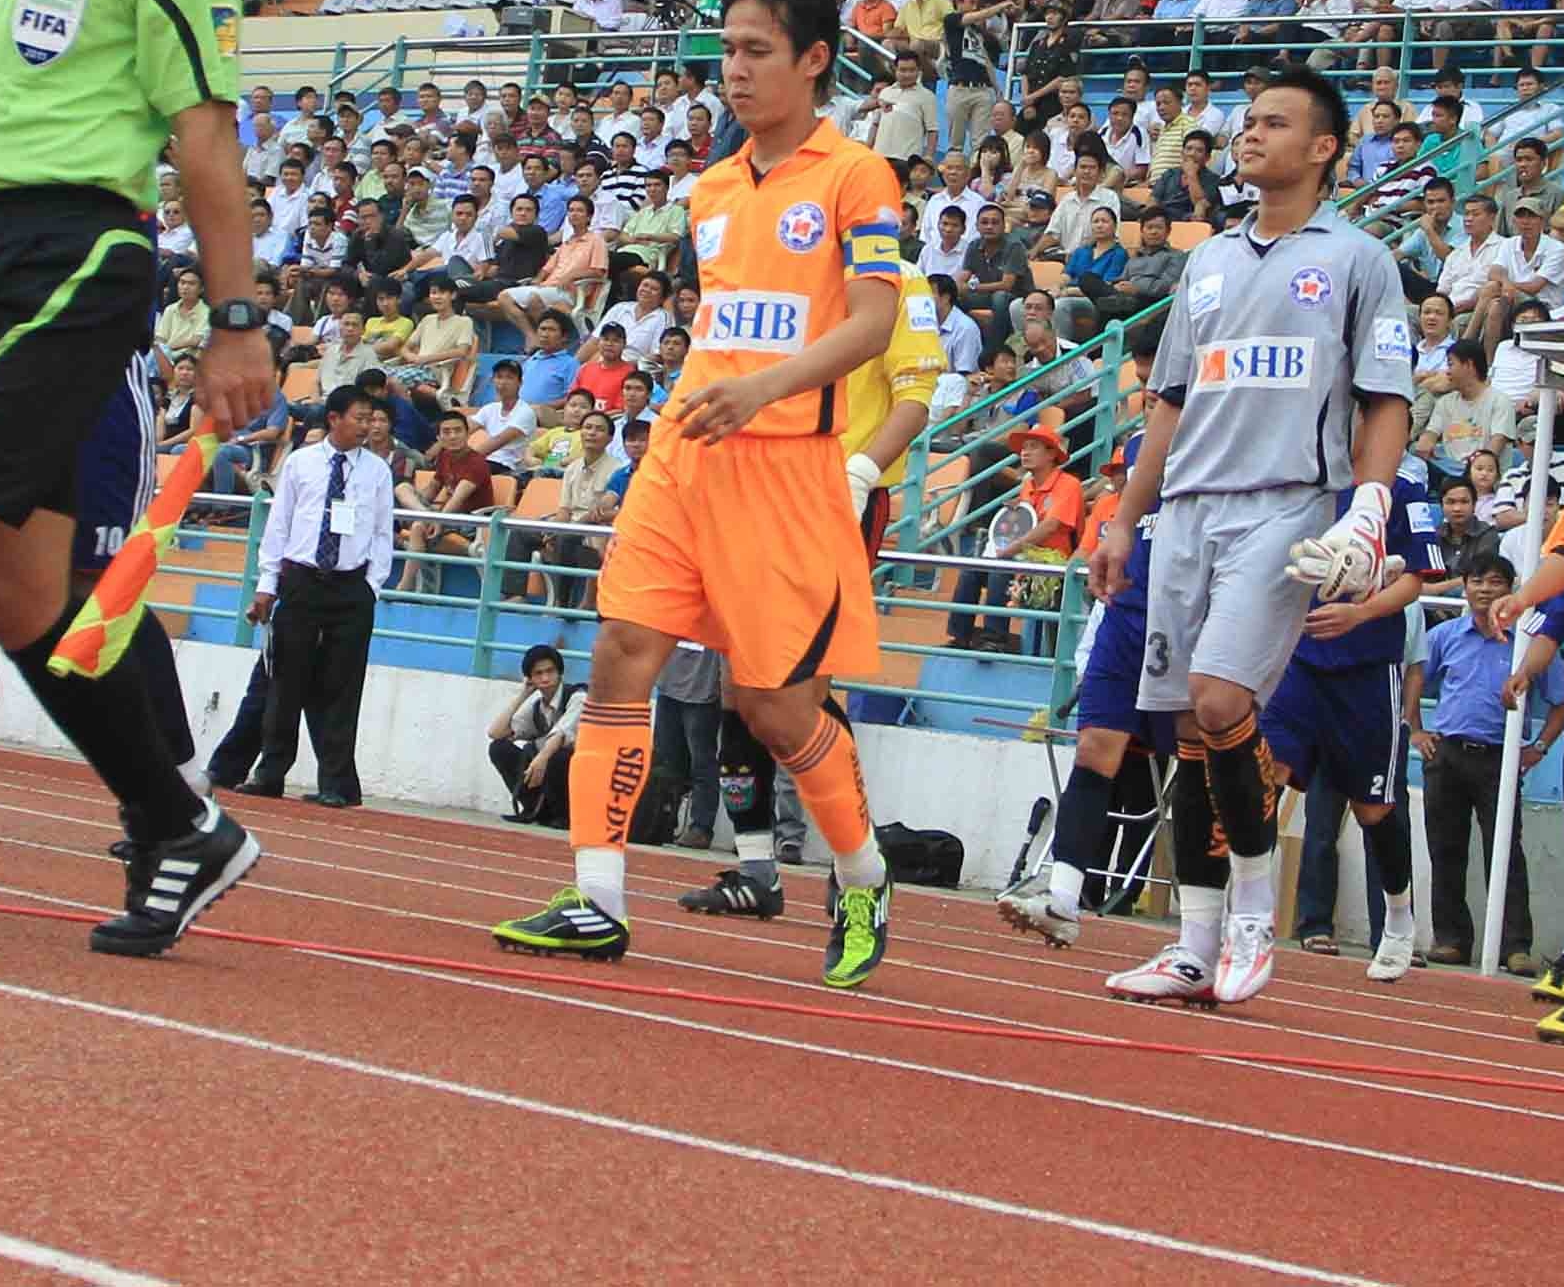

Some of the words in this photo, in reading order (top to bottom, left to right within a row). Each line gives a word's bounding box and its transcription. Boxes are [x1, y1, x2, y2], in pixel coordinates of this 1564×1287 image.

[20, 9, 66, 37] FIFA
[713, 300, 797, 341] SHB
[1232, 345, 1305, 378] SHB
[94, 526, 124, 556] 10
[1370, 774, 1385, 796] 2
